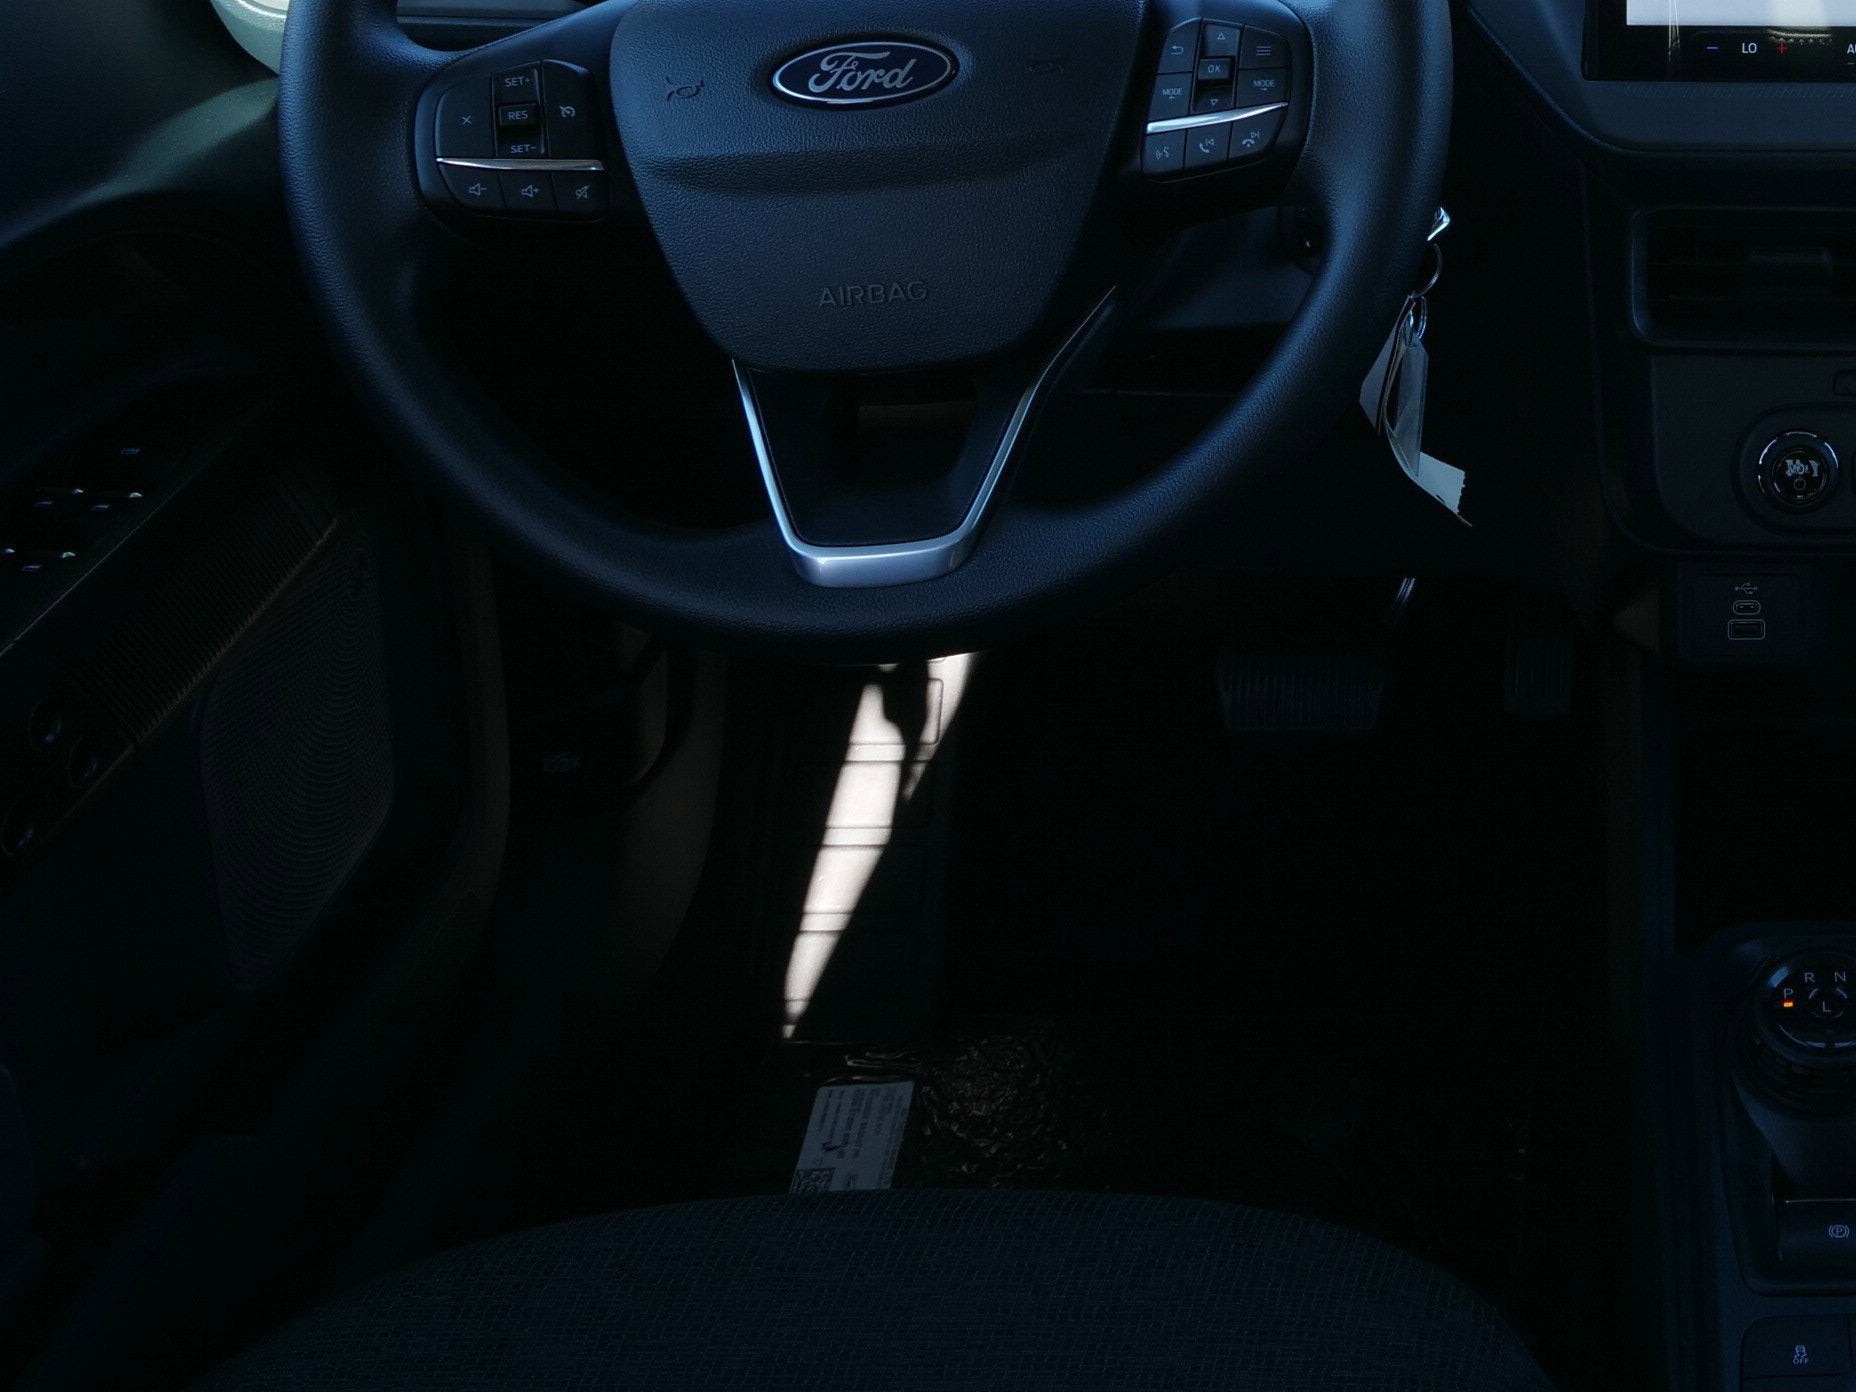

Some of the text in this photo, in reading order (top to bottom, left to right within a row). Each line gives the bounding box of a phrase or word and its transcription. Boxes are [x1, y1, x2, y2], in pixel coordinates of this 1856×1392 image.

[1741, 43, 1757, 54] LO
[808, 51, 917, 93] Ford
[1207, 64, 1221, 73] OK
[1253, 79, 1277, 87] MODE
[1162, 88, 1183, 96] MODE
[508, 110, 529, 121] RES
[818, 280, 929, 308] AIRBAG
[1783, 988, 1794, 999] P
[1804, 972, 1815, 983] R
[1834, 971, 1846, 982] N
[1822, 1001, 1832, 1012] L
